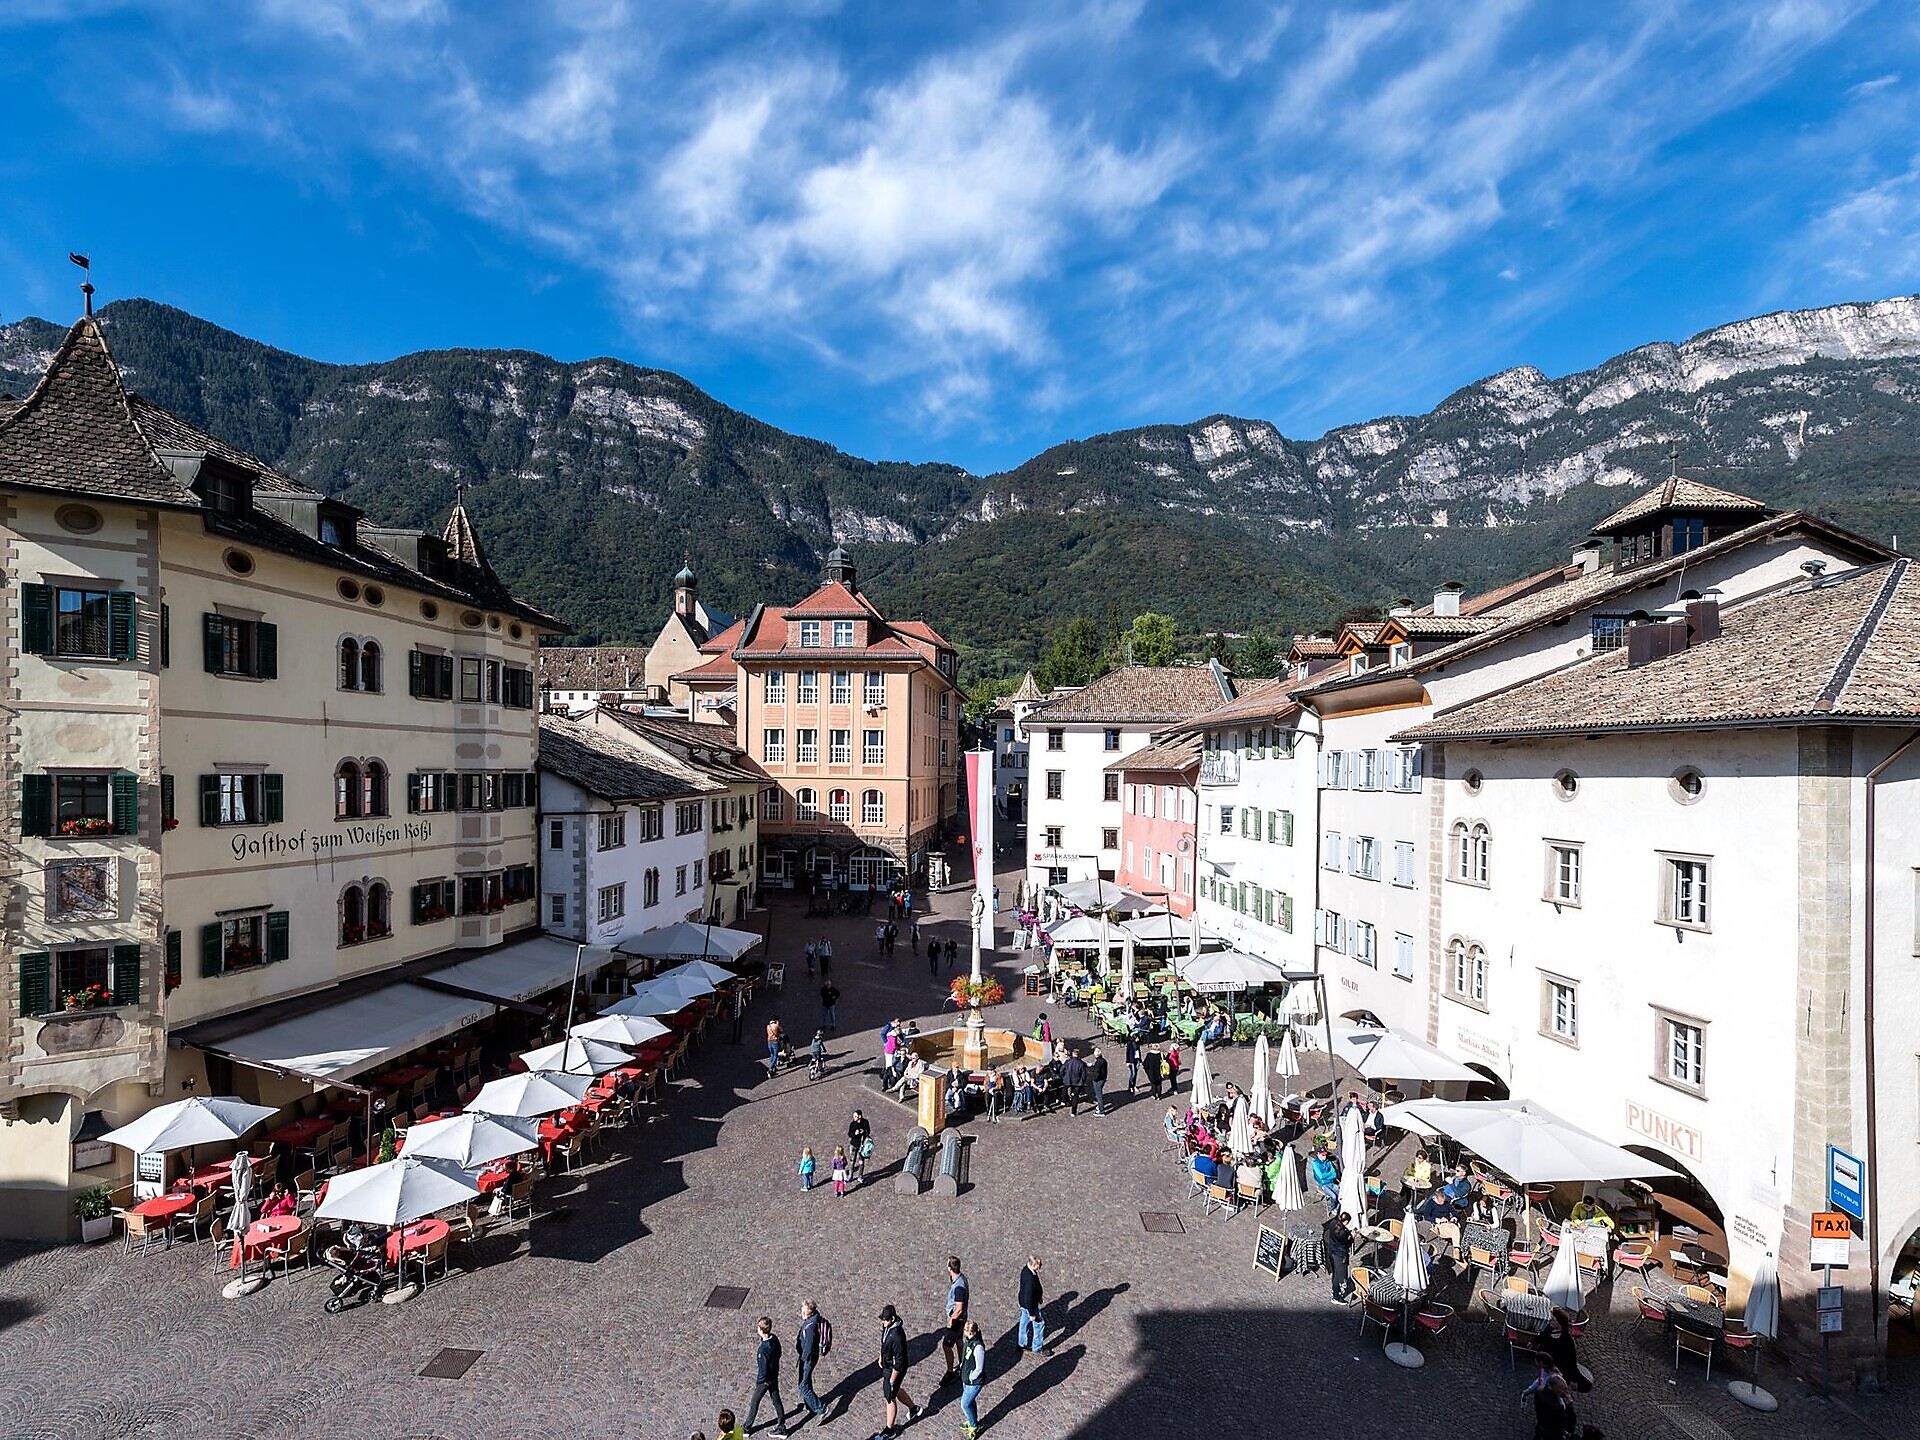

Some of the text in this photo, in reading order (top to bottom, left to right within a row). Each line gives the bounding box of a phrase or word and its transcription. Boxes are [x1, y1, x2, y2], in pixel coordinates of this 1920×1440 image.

[231, 829, 307, 860] Gasthof
[312, 832, 343, 853] zum
[346, 823, 400, 847] Weißen
[1200, 983, 1245, 991] RESTAURANT
[1628, 1103, 1699, 1155] PUNKT
[1833, 1188, 1859, 1207] CITYBUS
[1815, 1220, 1849, 1231] TAXI
